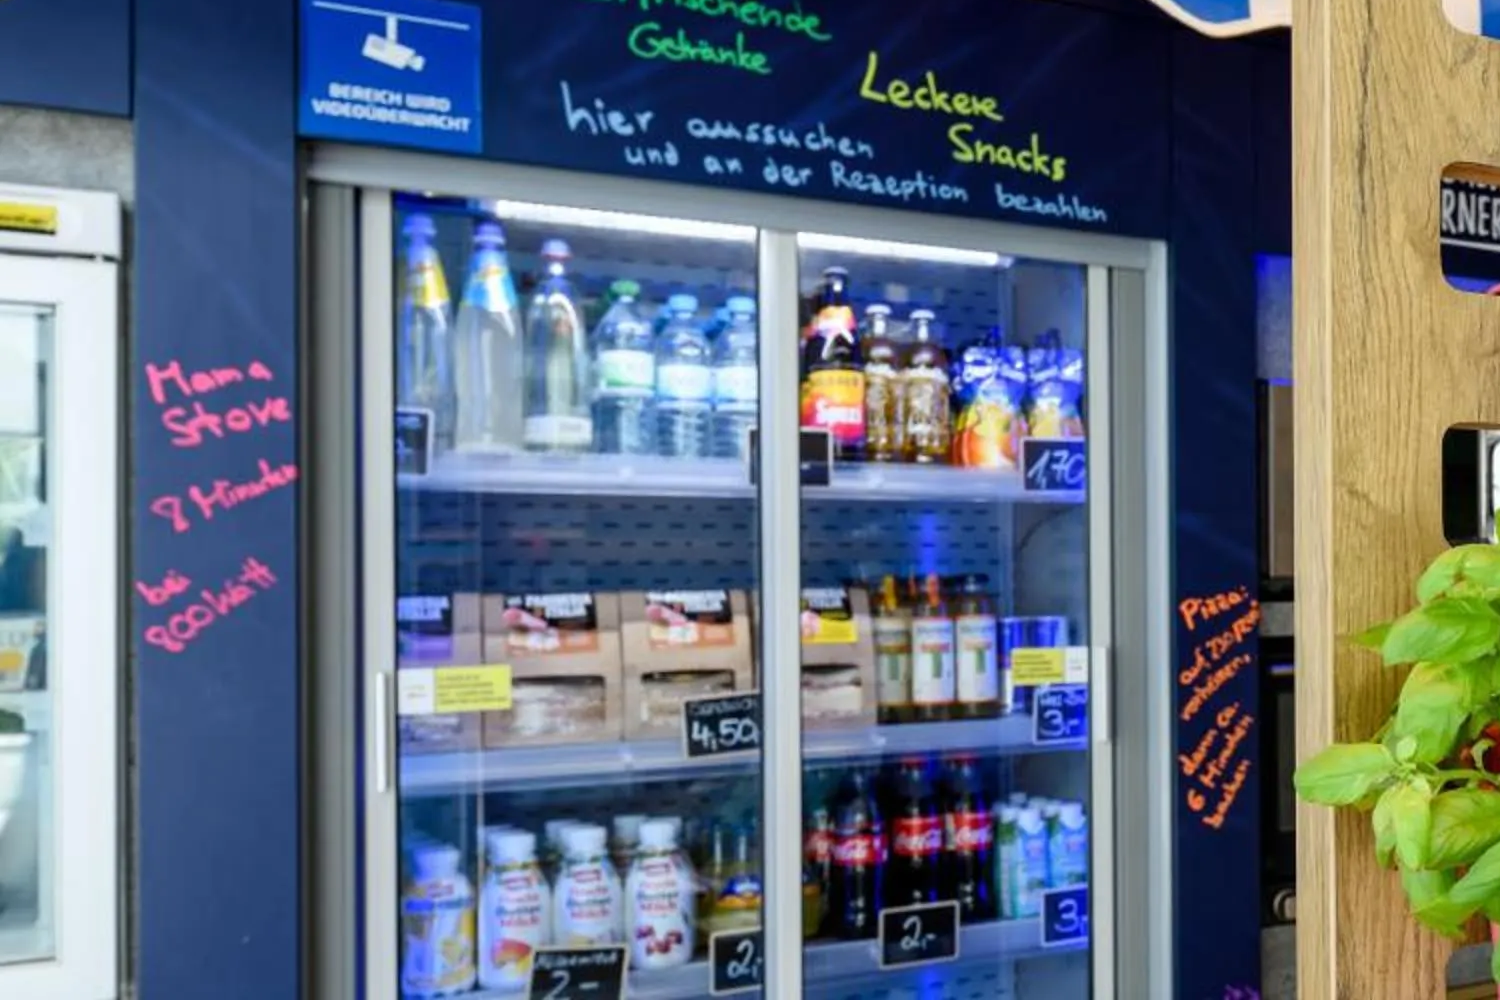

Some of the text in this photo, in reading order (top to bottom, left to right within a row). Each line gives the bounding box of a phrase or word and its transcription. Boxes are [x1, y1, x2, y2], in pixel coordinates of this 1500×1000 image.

[628, 22, 772, 74] Getränke
[311, 98, 471, 133] VIDEOÜBERWACHT
[329, 82, 451, 113] BEREICH WIRD
[860, 51, 1004, 121] Leckere
[560, 80, 874, 159] hier aussuchen
[948, 123, 1066, 182] Snacks
[624, 141, 1108, 224] und an der Rezeption bezahlen
